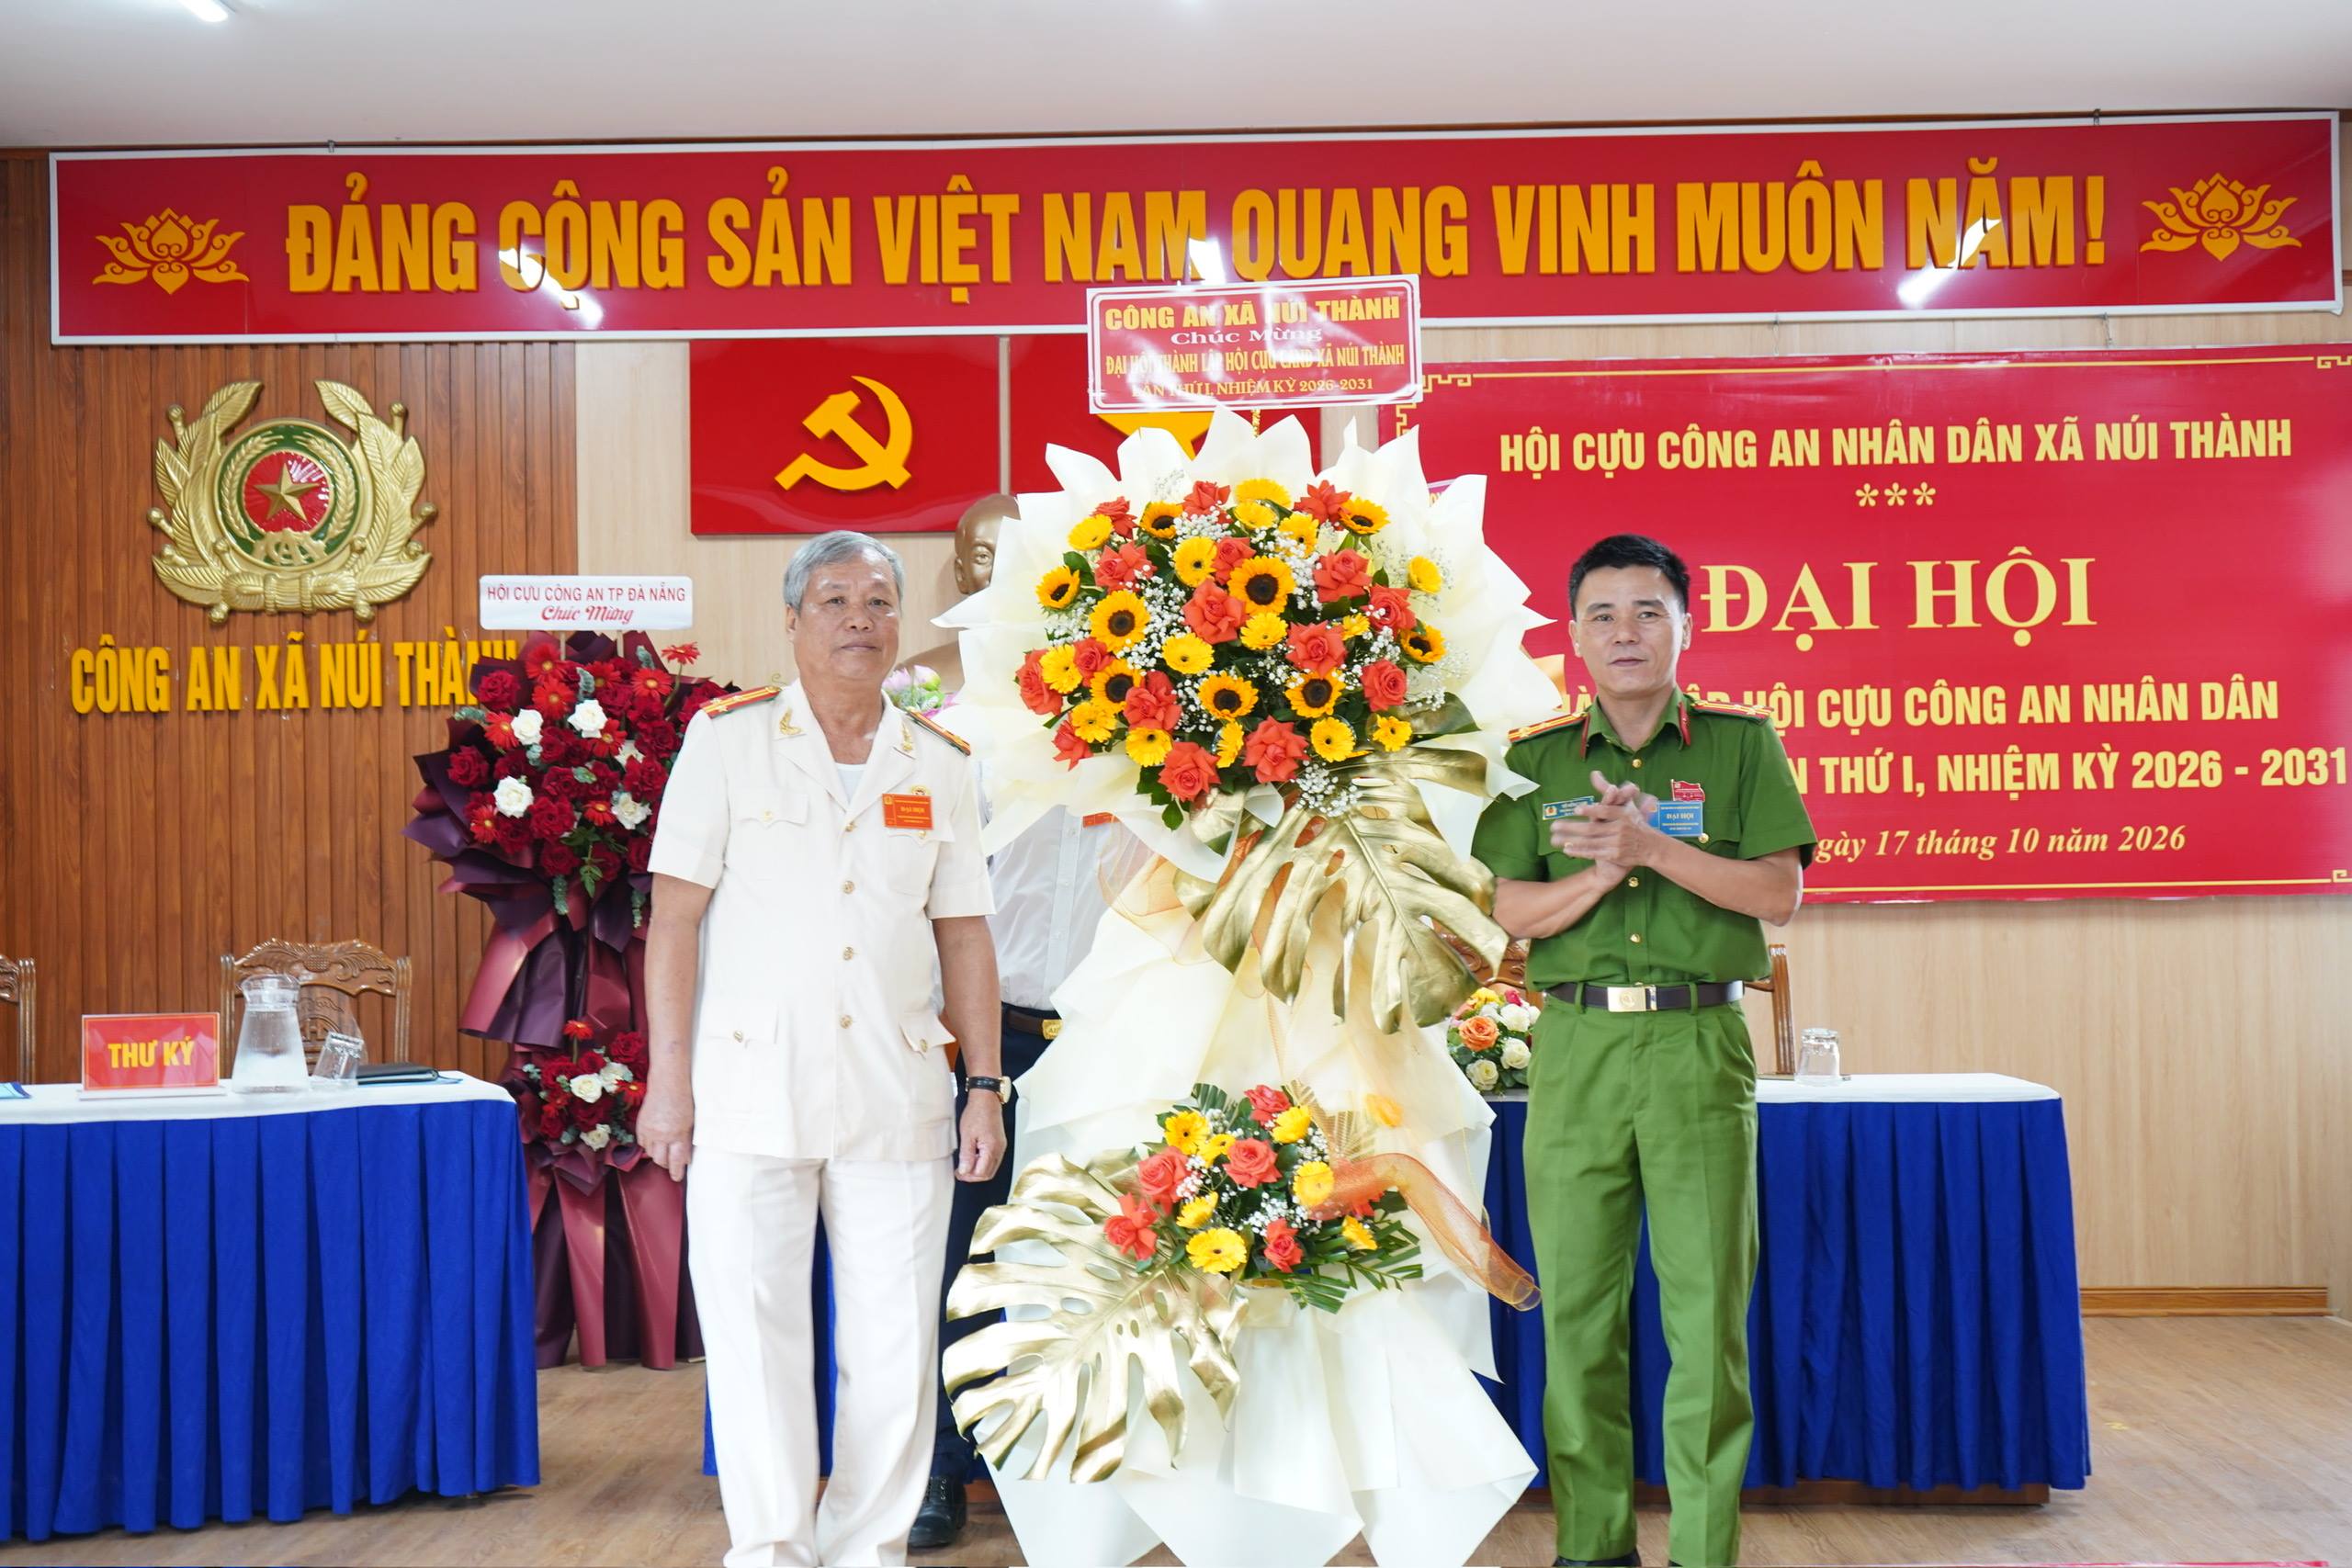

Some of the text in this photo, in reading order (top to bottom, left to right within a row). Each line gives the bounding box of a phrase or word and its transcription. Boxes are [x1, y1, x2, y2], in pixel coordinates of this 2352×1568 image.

[285, 171, 477, 292] ĐẢNG
[498, 179, 684, 310] CỘNG
[707, 165, 851, 288] SẢN
[874, 175, 1020, 304] VIỆT
[1043, 190, 1206, 283] NAM
[1231, 186, 1467, 283] QUANG
[1493, 183, 1655, 276] VINH
[1677, 160, 1883, 273] MUÔN
[1105, 304, 1174, 331] CÔNG
[1182, 306, 1216, 327] AN
[1224, 300, 1257, 326] XÃ
[1316, 295, 1400, 322] THÀNH
[1170, 327, 1323, 345] Chúc Mừng
[1105, 355, 1126, 378] ĐẠI
[1226, 347, 1249, 375] HỘI
[1337, 342, 1359, 367] NÚI
[1363, 341, 1405, 367] THÀNH
[1216, 378, 1270, 397] NHIỆM
[1273, 378, 1296, 393] KỲ
[1500, 412, 2291, 479] HỘI CỰU CÔNG AN NHÂN DÂN XÃ NÚI THÀNH
[487, 583, 509, 603] HỘI
[514, 585, 540, 603] CỰU
[545, 583, 582, 601] CÔNG
[586, 588, 604, 601] AN
[608, 588, 624, 601] TP
[628, 583, 645, 601] ĐÀ
[1701, 547, 2097, 651] ĐẠI HỘI
[71, 633, 170, 714] CÔNG
[187, 646, 240, 711] AN
[254, 631, 310, 710] XÃ
[321, 629, 382, 709] NÚI
[1818, 682, 1892, 738] CỰU
[1905, 679, 2007, 726] CÔNG
[2018, 684, 2071, 724] AN
[2083, 675, 2188, 723] NHÂN
[2200, 673, 2278, 720] DÂN
[1820, 747, 1894, 795] THỨ
[1903, 755, 1925, 797] I,
[1937, 744, 2061, 800] NHIỆM
[2072, 743, 2120, 790] KỲ
[2132, 750, 2222, 790] 2026
[2261, 747, 2346, 786] 2031
[1815, 825, 2187, 863] gày 17 tháng 10 năm 2026
[107, 1035, 195, 1068] THƯ KÝ
